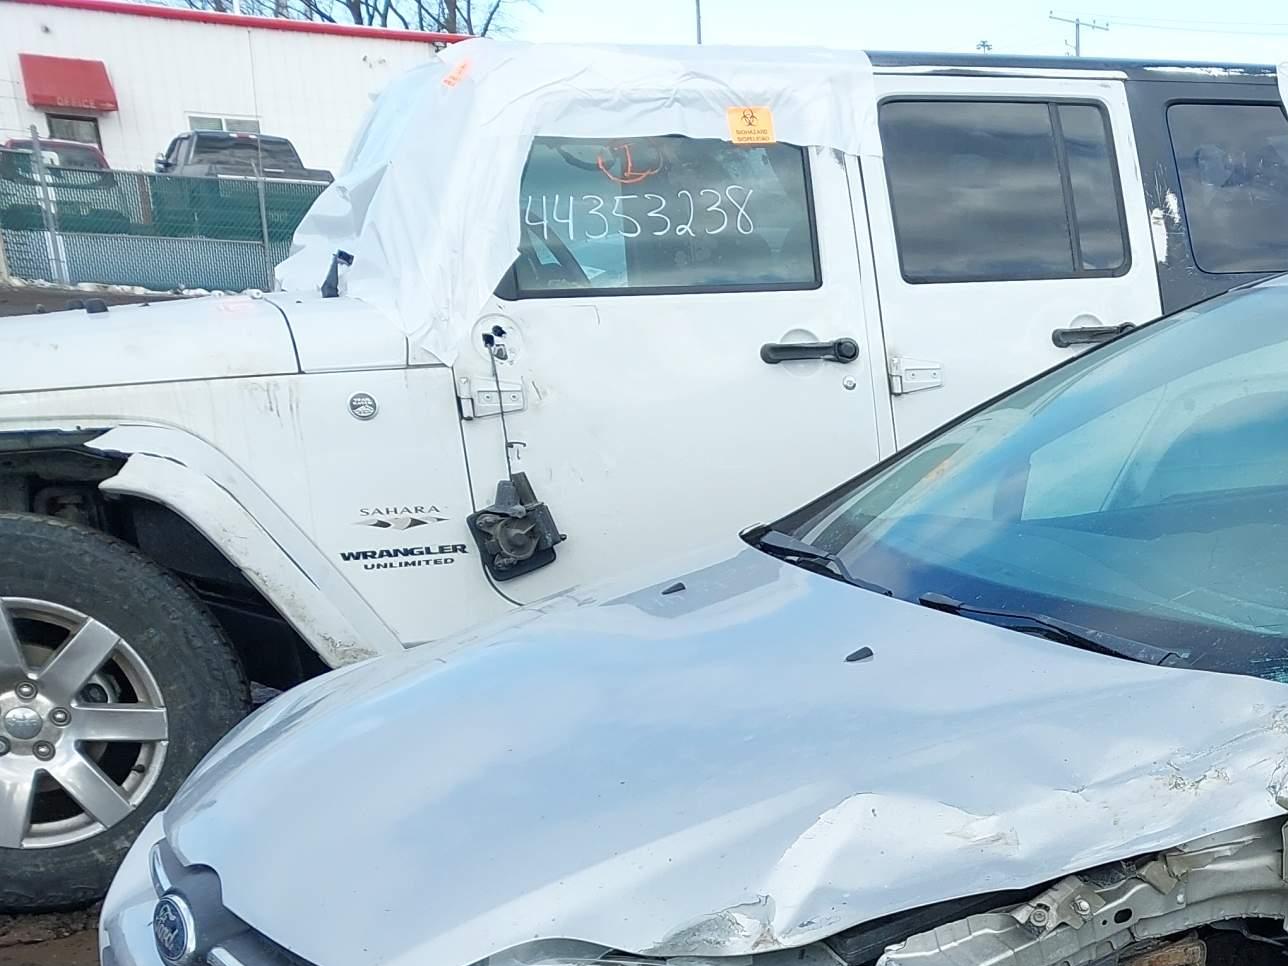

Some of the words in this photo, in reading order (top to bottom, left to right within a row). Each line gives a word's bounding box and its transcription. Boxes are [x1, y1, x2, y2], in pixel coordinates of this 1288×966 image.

[524, 185, 755, 241] 44353238
[359, 505, 441, 517] SAHARA
[339, 543, 470, 562] WRANGLER
[363, 557, 455, 570] UNLIMITED
[155, 903, 179, 951] Ford
